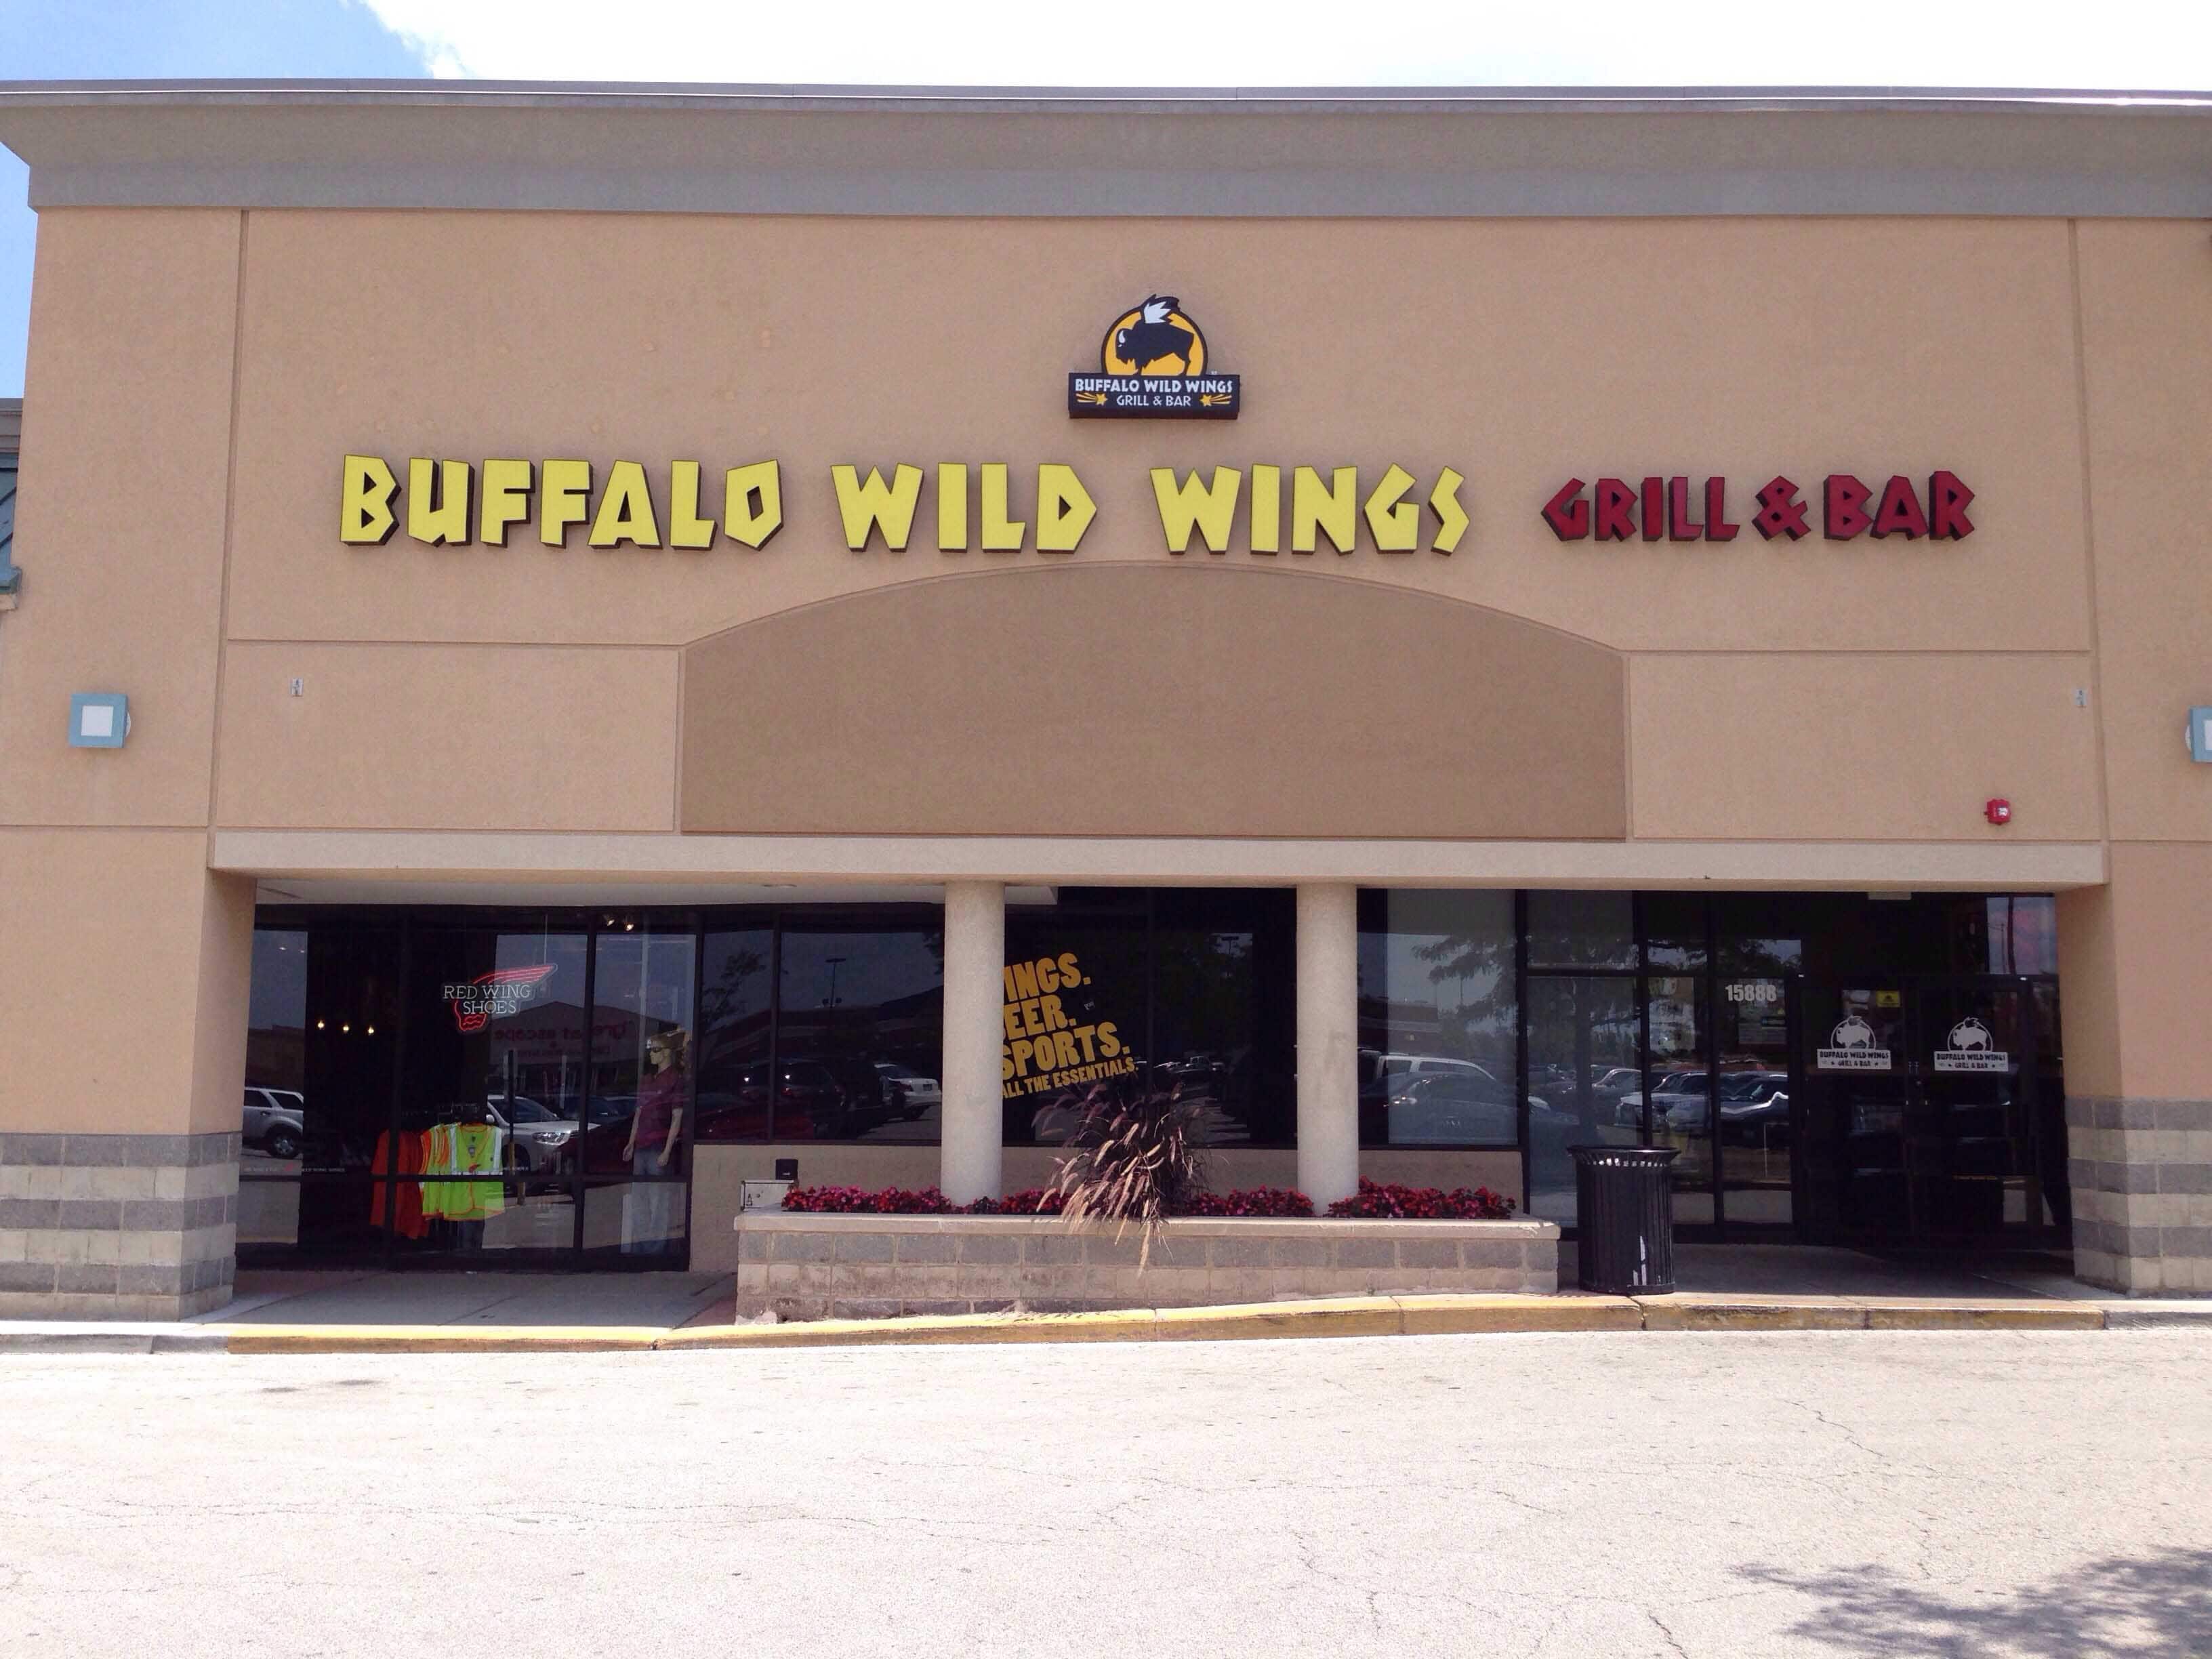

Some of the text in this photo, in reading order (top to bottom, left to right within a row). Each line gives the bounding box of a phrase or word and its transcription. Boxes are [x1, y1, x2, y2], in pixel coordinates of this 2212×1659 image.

[1075, 378, 1233, 394] BUFFALO WILD WINGS
[1116, 395, 1192, 407] GRILL & BAR
[339, 455, 1469, 553] BUFFALO WILD WINGS
[1542, 470, 1975, 541] GRILL & BAR
[1003, 952, 1091, 1002] INGS.
[444, 984, 532, 999] RED WING
[1725, 984, 1777, 1002] 15888
[463, 1000, 516, 1015] SHOES
[1003, 994, 1077, 1040] EER.
[1024, 1073, 1052, 1094] THE
[1052, 1057, 1139, 1088] ESSENTIALS.
